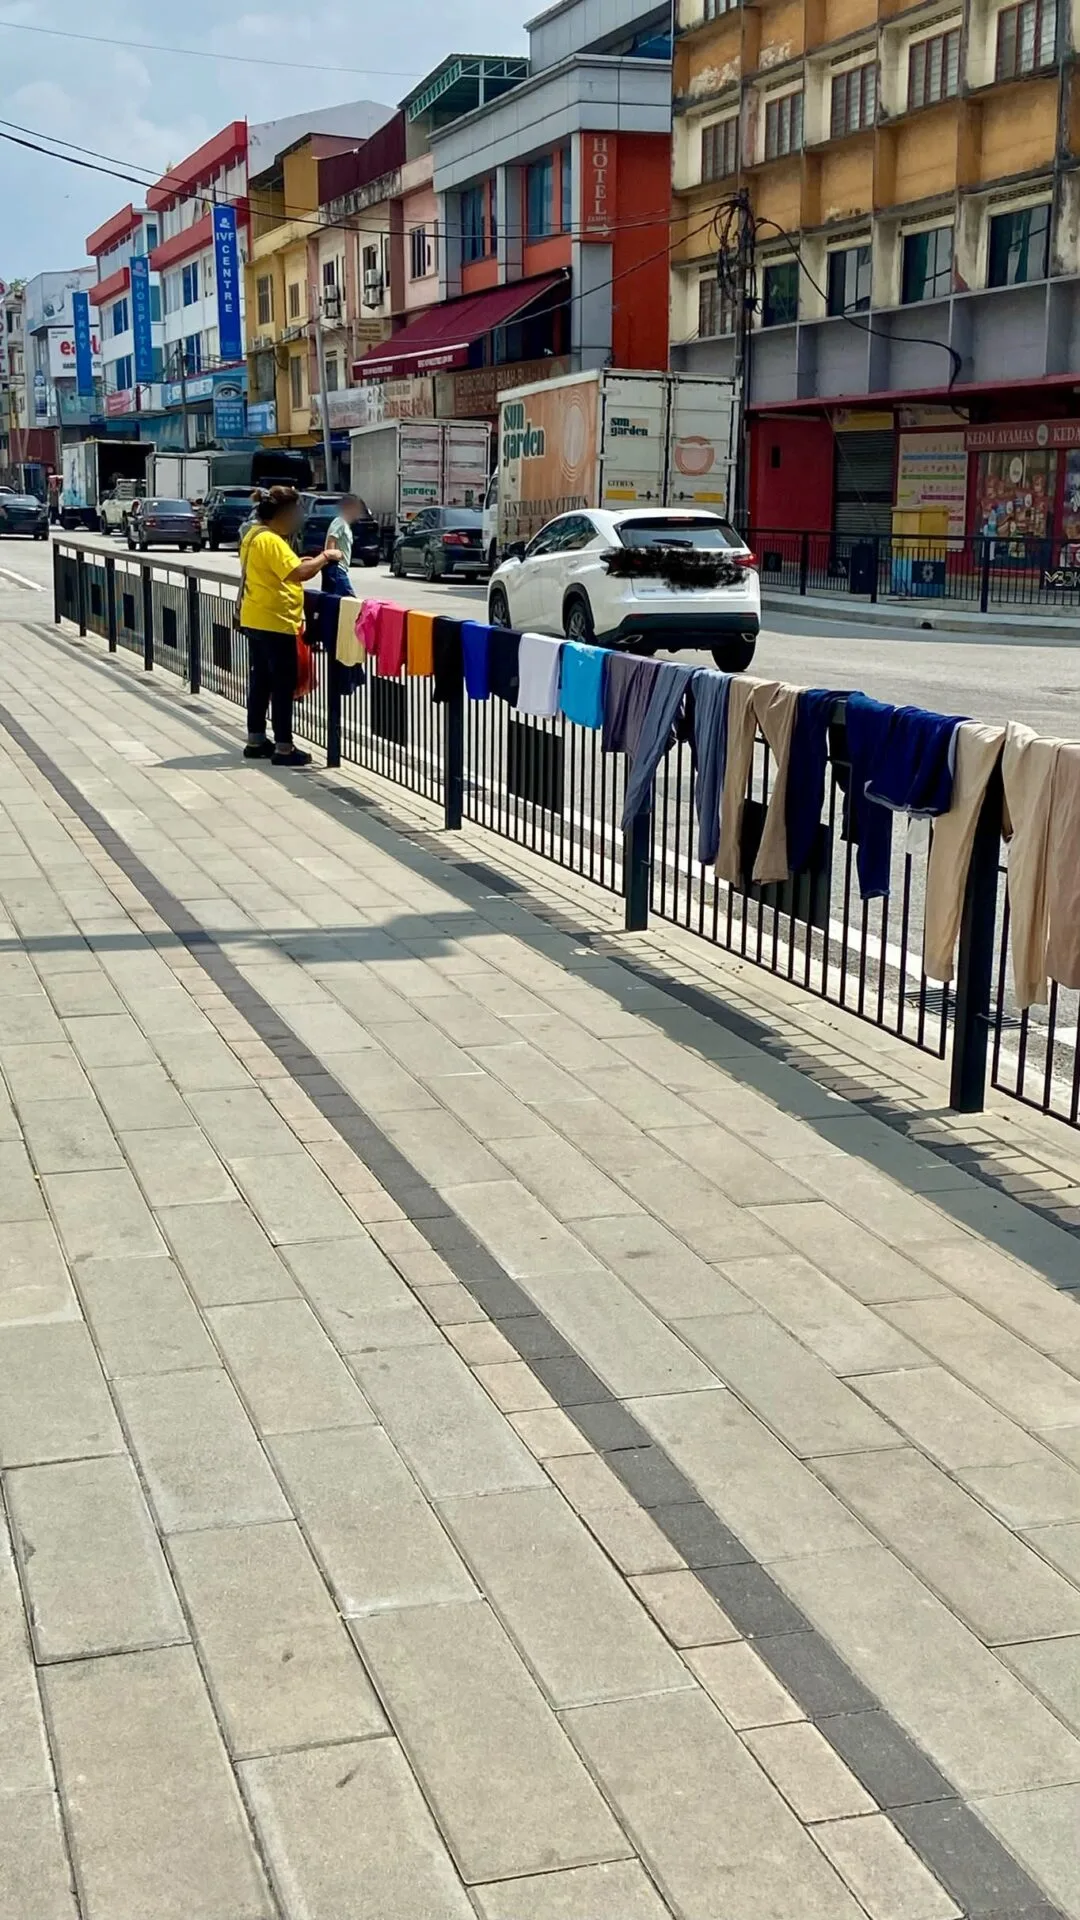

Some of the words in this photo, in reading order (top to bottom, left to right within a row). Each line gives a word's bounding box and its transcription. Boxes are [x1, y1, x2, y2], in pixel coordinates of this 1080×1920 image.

[592, 138, 608, 214] HOTEL
[216, 232, 235, 242] IVF
[222, 245, 233, 313] CENTRE
[135, 280, 148, 367] HOSPITAL
[504, 404, 524, 431] sun
[610, 425, 648, 436] garden
[967, 430, 995, 445] KEDAI
[998, 428, 1034, 444] AYAMAS
[503, 422, 544, 467] garden
[402, 487, 437, 496] garden
[503, 500, 553, 517] AUSTRALIAN
[556, 495, 588, 513] CITRUS
